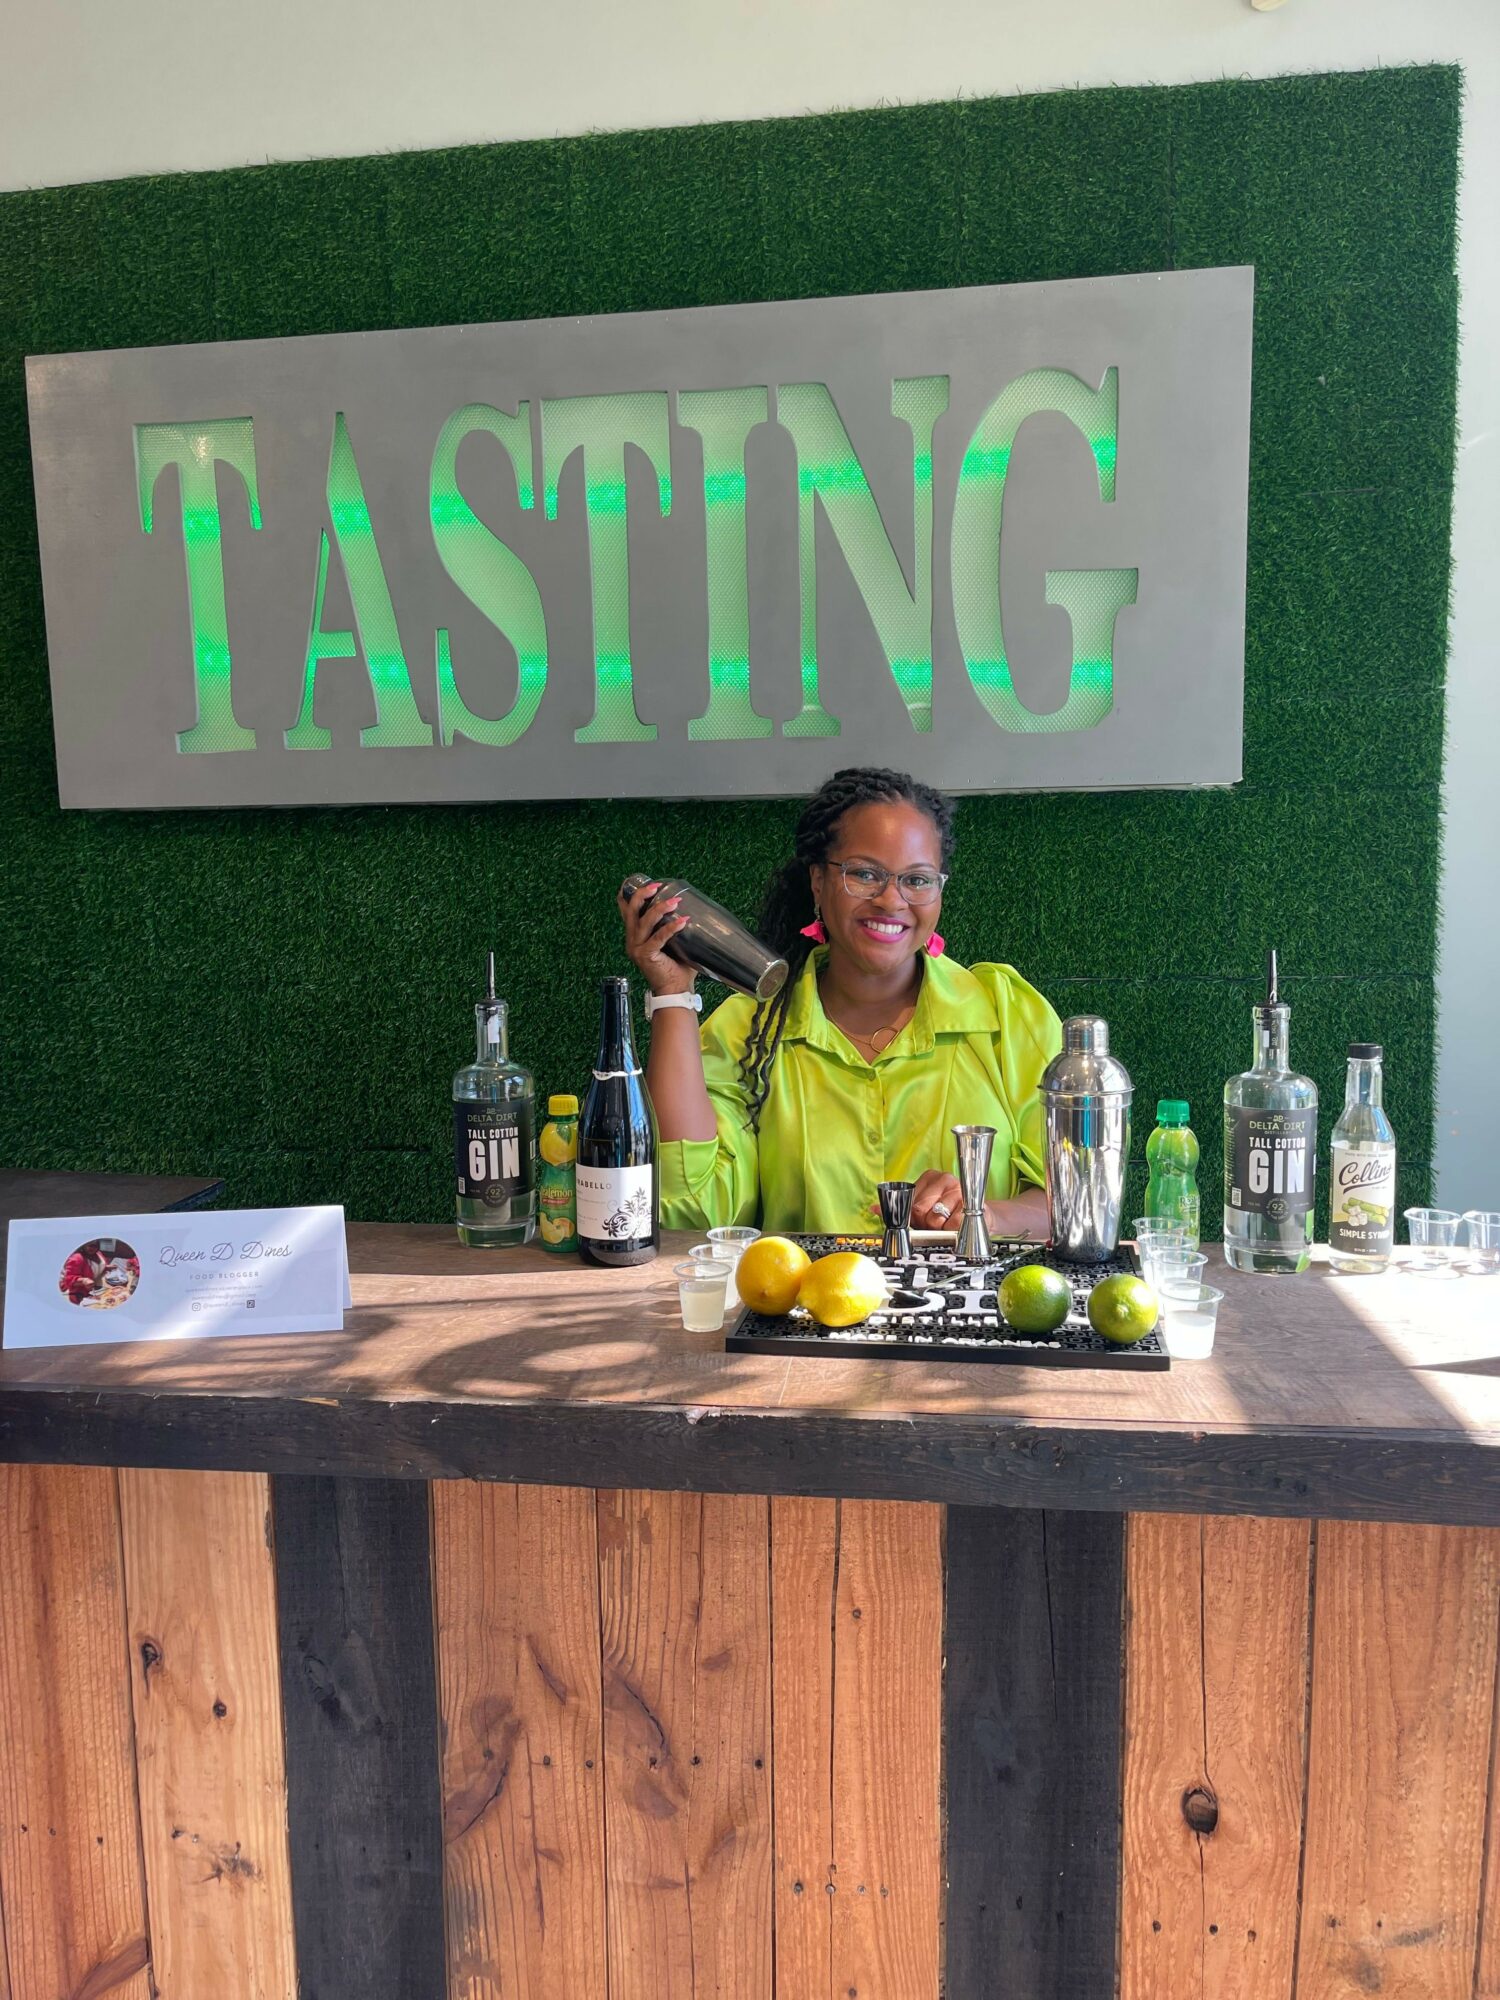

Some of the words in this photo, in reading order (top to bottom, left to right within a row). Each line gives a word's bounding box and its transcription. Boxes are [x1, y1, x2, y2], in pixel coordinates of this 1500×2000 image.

[135, 362, 1138, 755] TASTING
[467, 1114, 492, 1122] DELTA
[496, 1112, 517, 1123] DIRT
[467, 1128, 487, 1139] TALL
[489, 1126, 519, 1139] COTTON
[1249, 1121, 1280, 1130] DELTA
[1283, 1121, 1305, 1133] DIRT
[1249, 1136, 1272, 1149] TALL
[1275, 1137, 1306, 1149] COTTON
[468, 1137, 520, 1182] GIN
[1248, 1149, 1306, 1194] GIN
[1338, 1160, 1391, 1186] Collins
[1271, 1203, 1284, 1211] 92
[1340, 1228, 1366, 1240] SIMPLE
[159, 1245, 206, 1267] Queen
[210, 1242, 234, 1261] D
[239, 1240, 292, 1260] Dines
[219, 1271, 259, 1279] BLOGGER
